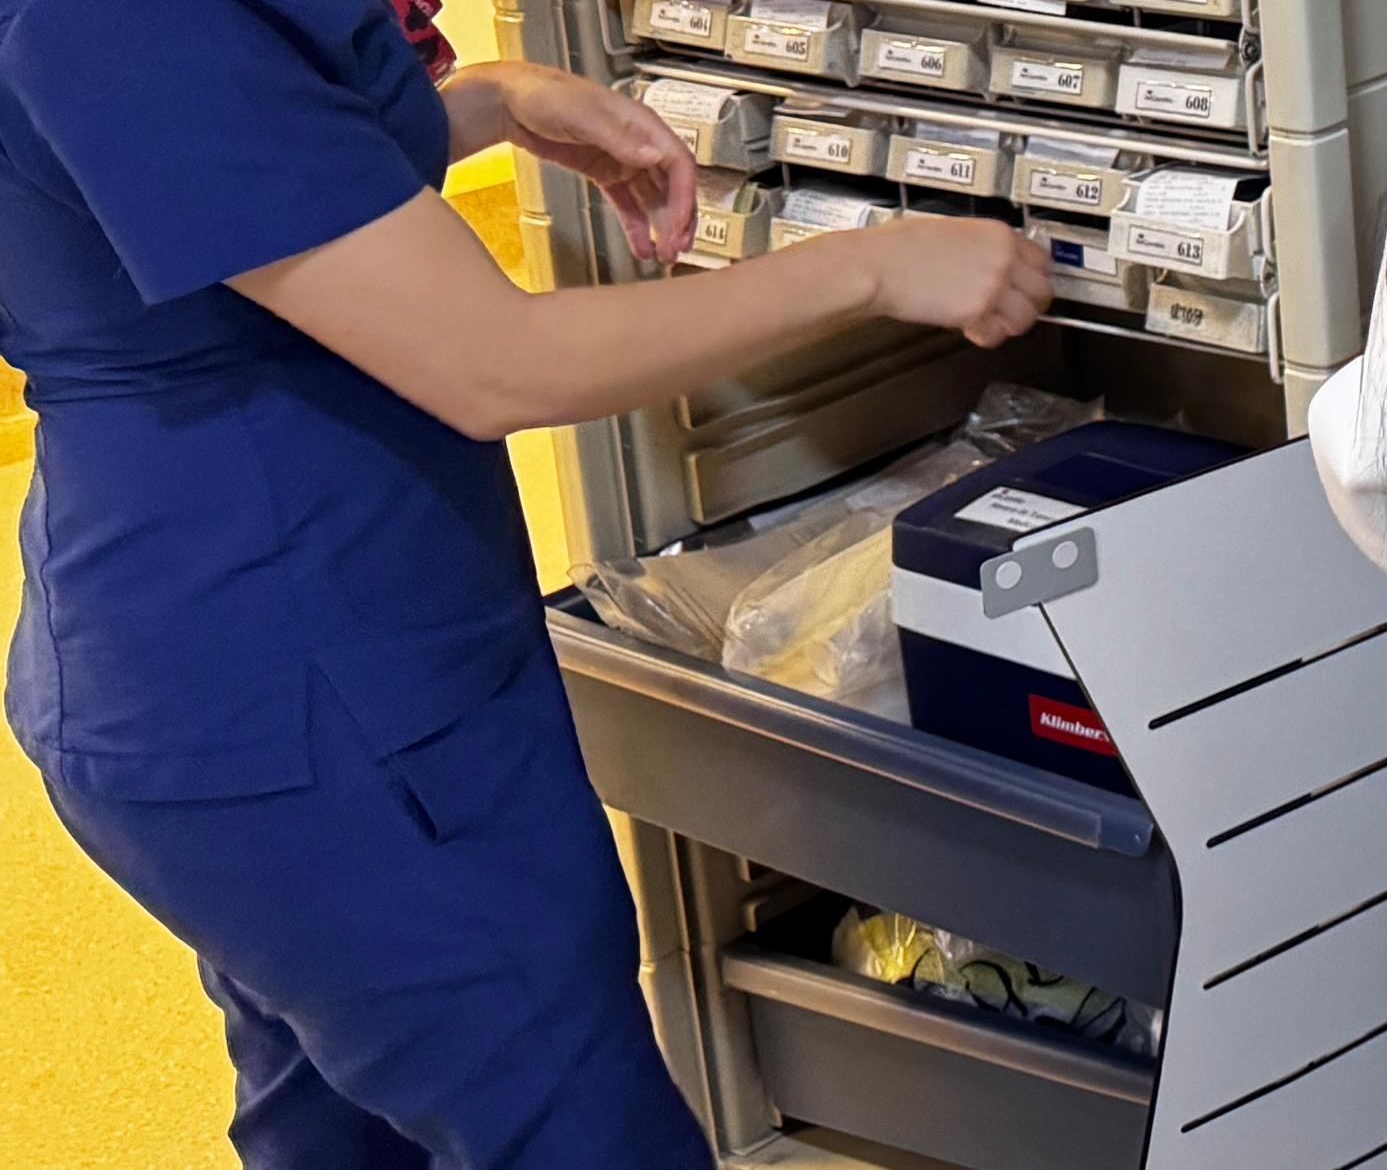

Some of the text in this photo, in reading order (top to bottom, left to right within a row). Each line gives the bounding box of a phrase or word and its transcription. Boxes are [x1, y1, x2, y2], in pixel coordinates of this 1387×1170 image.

[689, 16, 708, 32] 604
[785, 39, 808, 55] 605
[921, 55, 942, 71] 606
[1058, 74, 1082, 90] 607
[1185, 96, 1209, 112] 608
[827, 144, 849, 159] 610
[950, 164, 971, 180] 611
[1076, 183, 1100, 200] 612
[1177, 243, 1201, 260] 613
